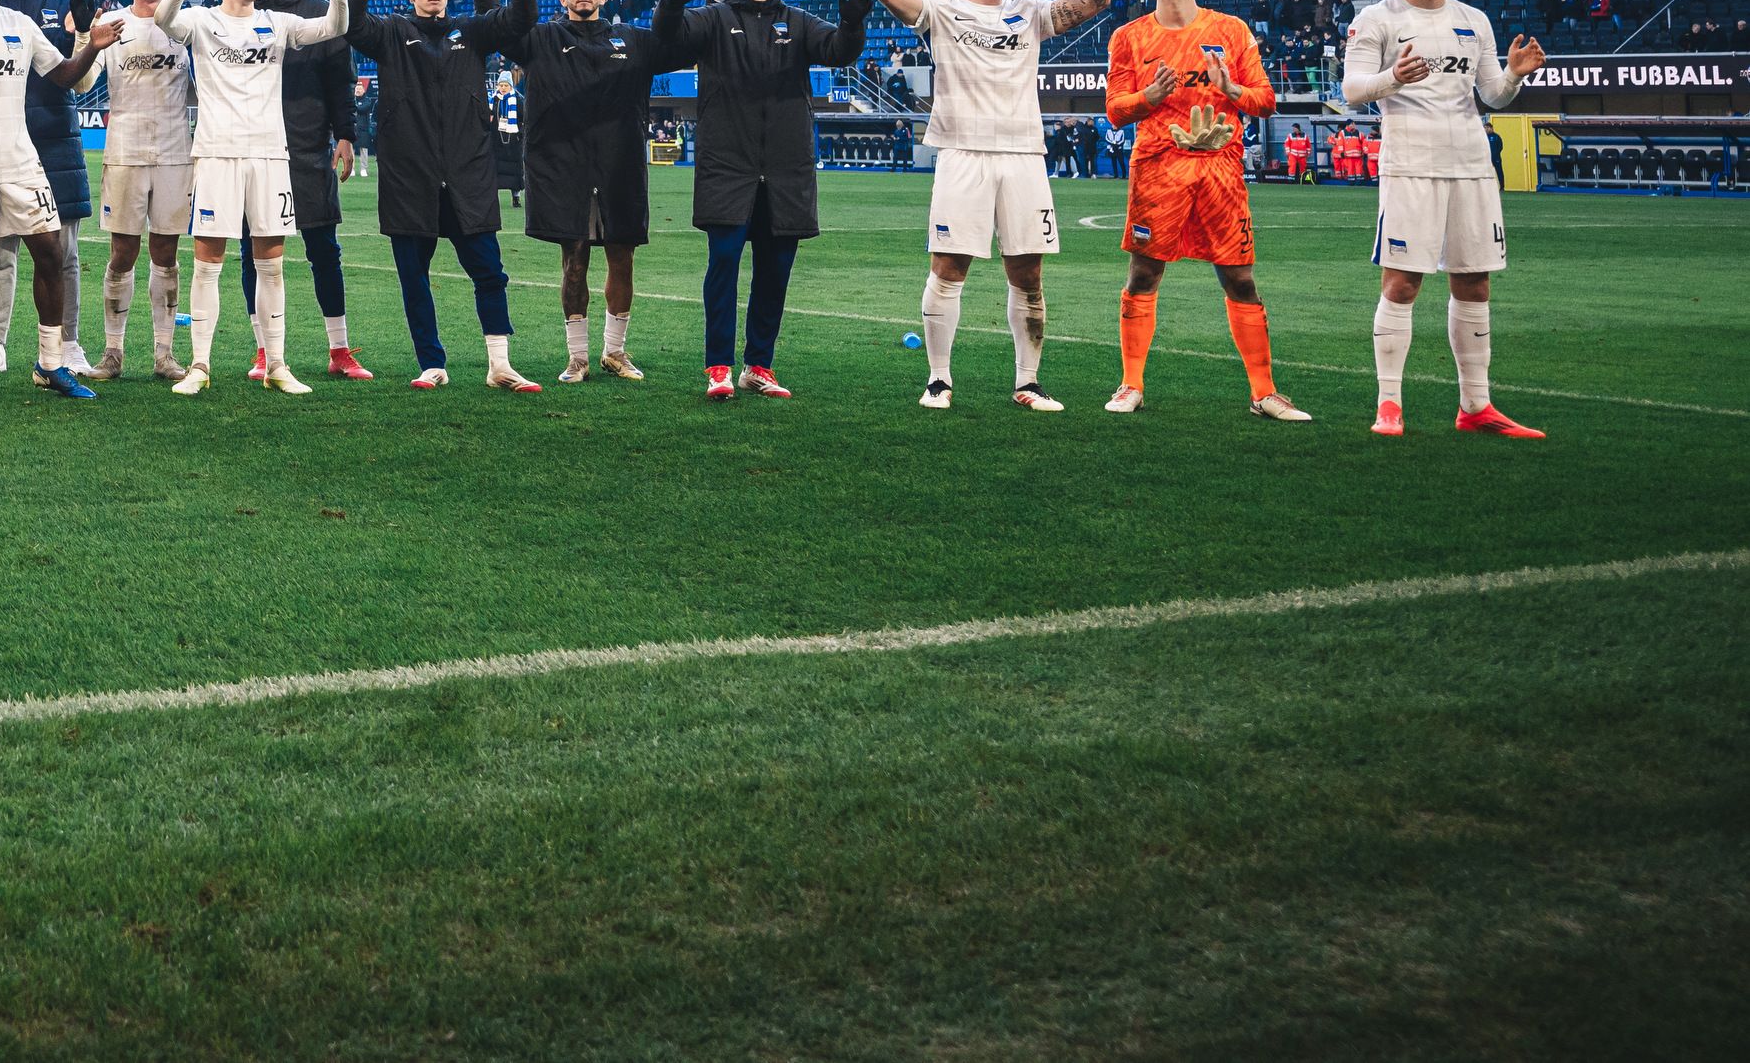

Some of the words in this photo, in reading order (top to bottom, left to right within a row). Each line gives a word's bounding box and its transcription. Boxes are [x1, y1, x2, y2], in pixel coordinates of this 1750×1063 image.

[1618, 65, 1733, 86] FUßBALL.
[834, 90, 848, 100] T/U
[278, 191, 295, 218] 22
[1493, 223, 1505, 251] 4
